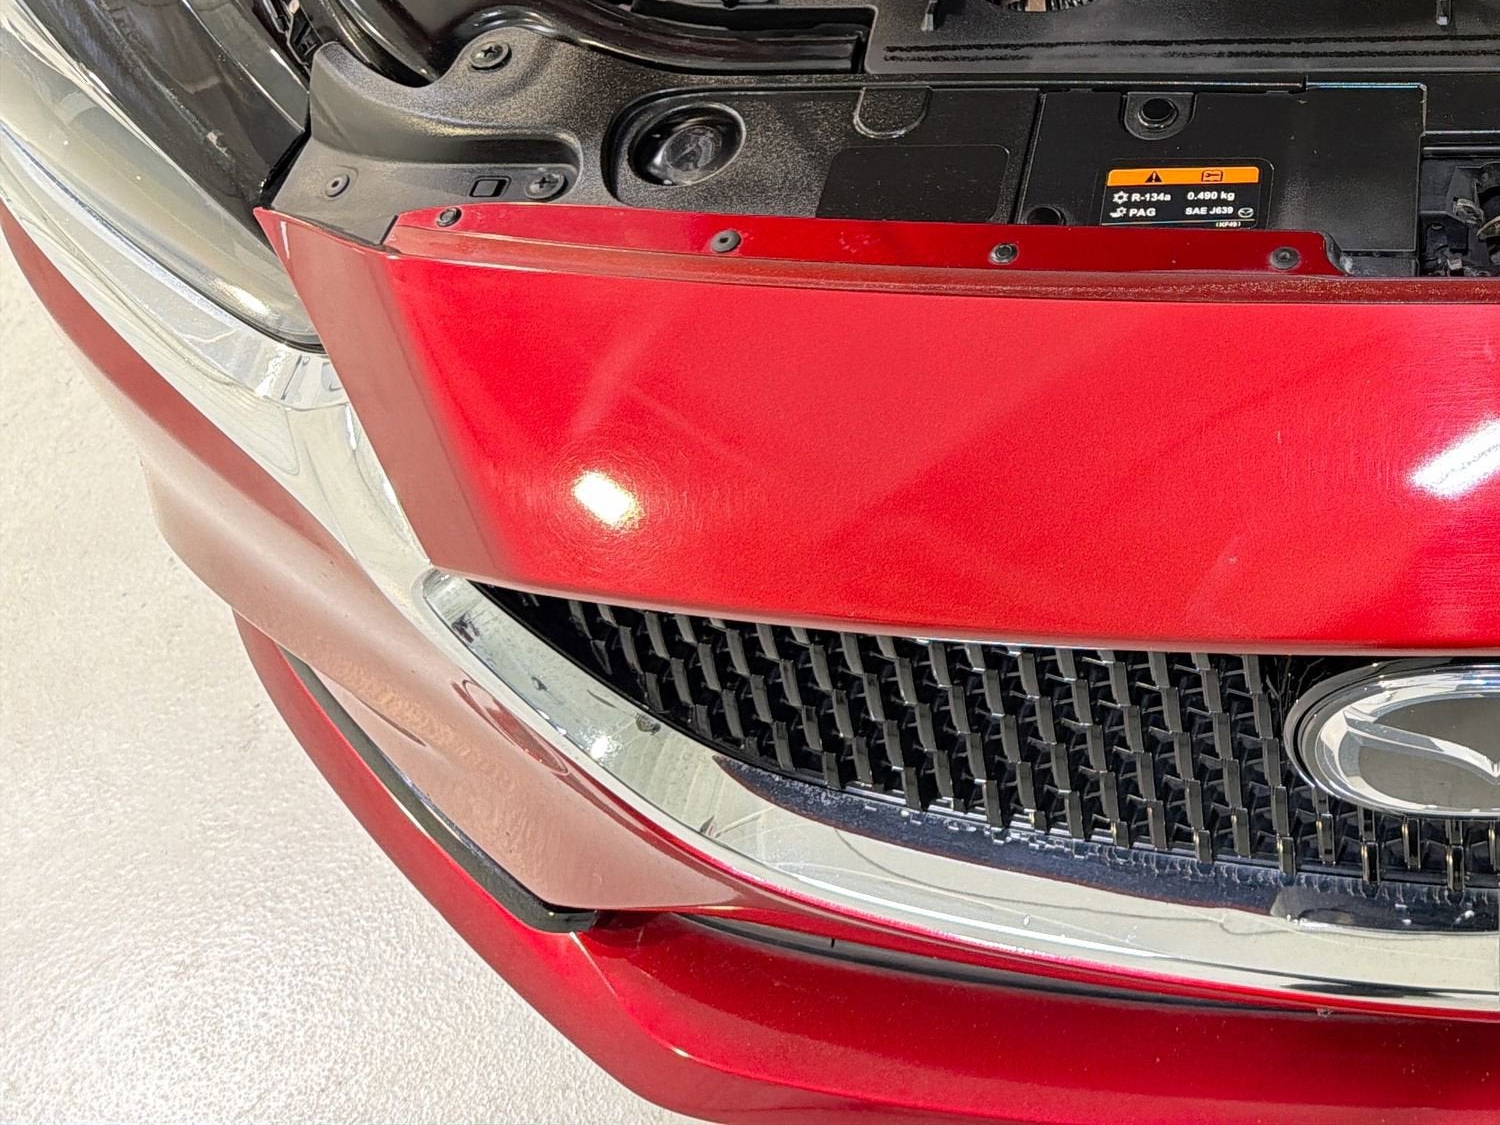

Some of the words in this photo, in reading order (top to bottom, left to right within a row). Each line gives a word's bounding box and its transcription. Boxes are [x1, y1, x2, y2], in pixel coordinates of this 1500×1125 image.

[1130, 192, 1172, 202] R-134a
[1186, 191, 1218, 201] 0.490
[1220, 190, 1235, 201] kg
[1128, 207, 1156, 217] PAG
[1185, 206, 1208, 216] SAE
[1209, 206, 1234, 215] J639
